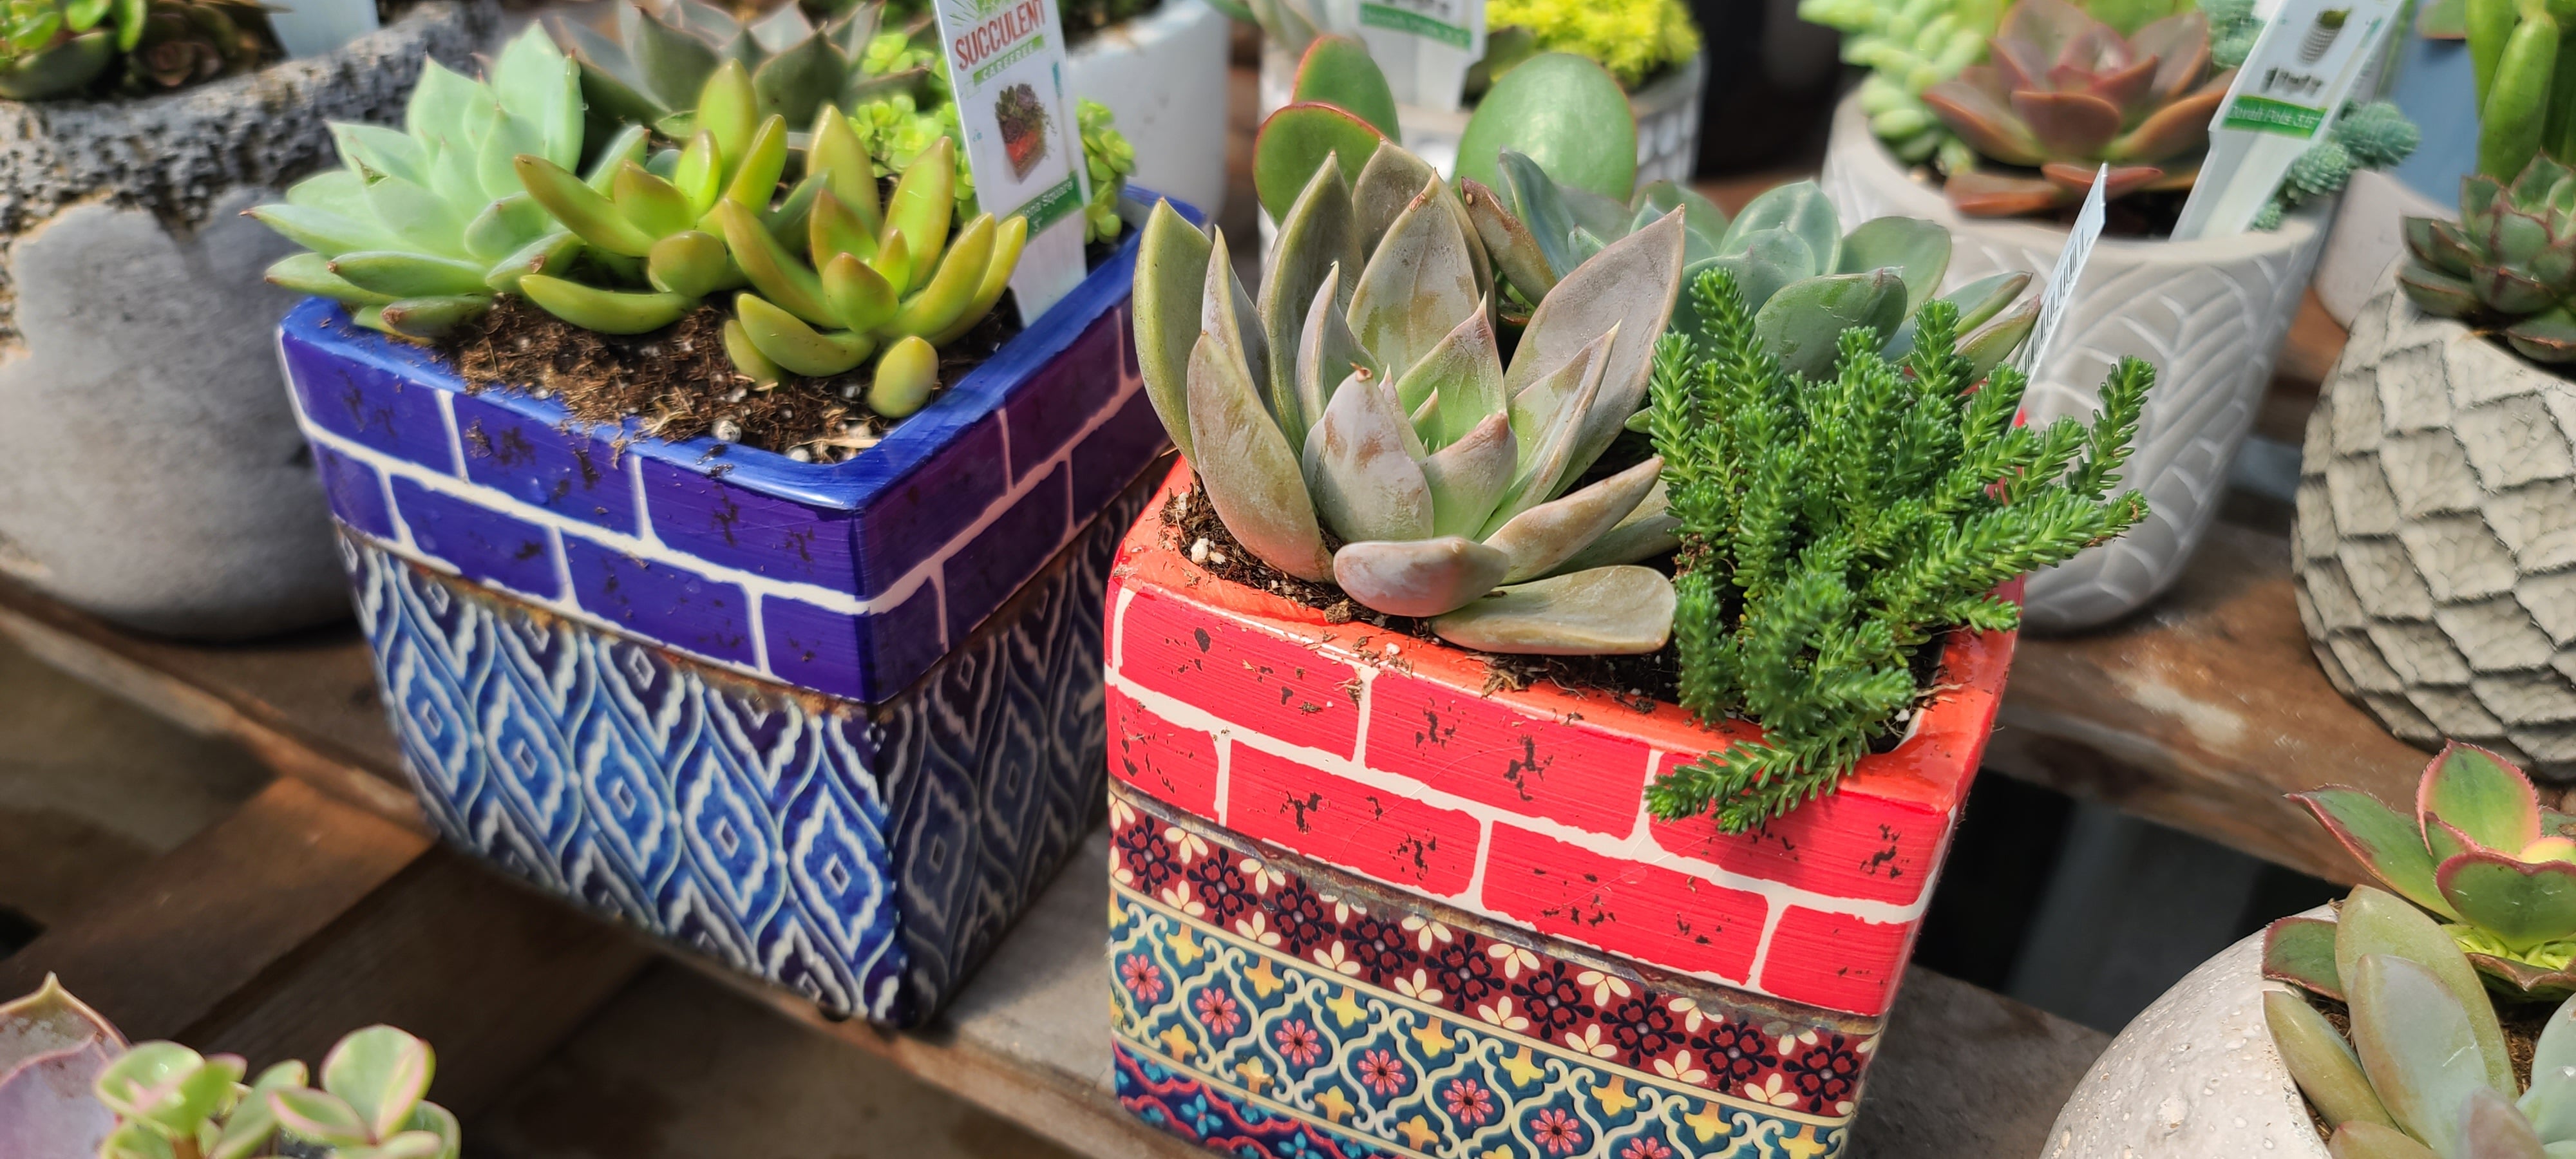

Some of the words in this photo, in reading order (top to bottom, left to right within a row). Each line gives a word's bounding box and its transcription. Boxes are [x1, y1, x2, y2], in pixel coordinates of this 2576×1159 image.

[955, 0, 1046, 71] SUCCULENT
[983, 42, 1034, 80] CAREFREE
[1042, 181, 1072, 206] Square
